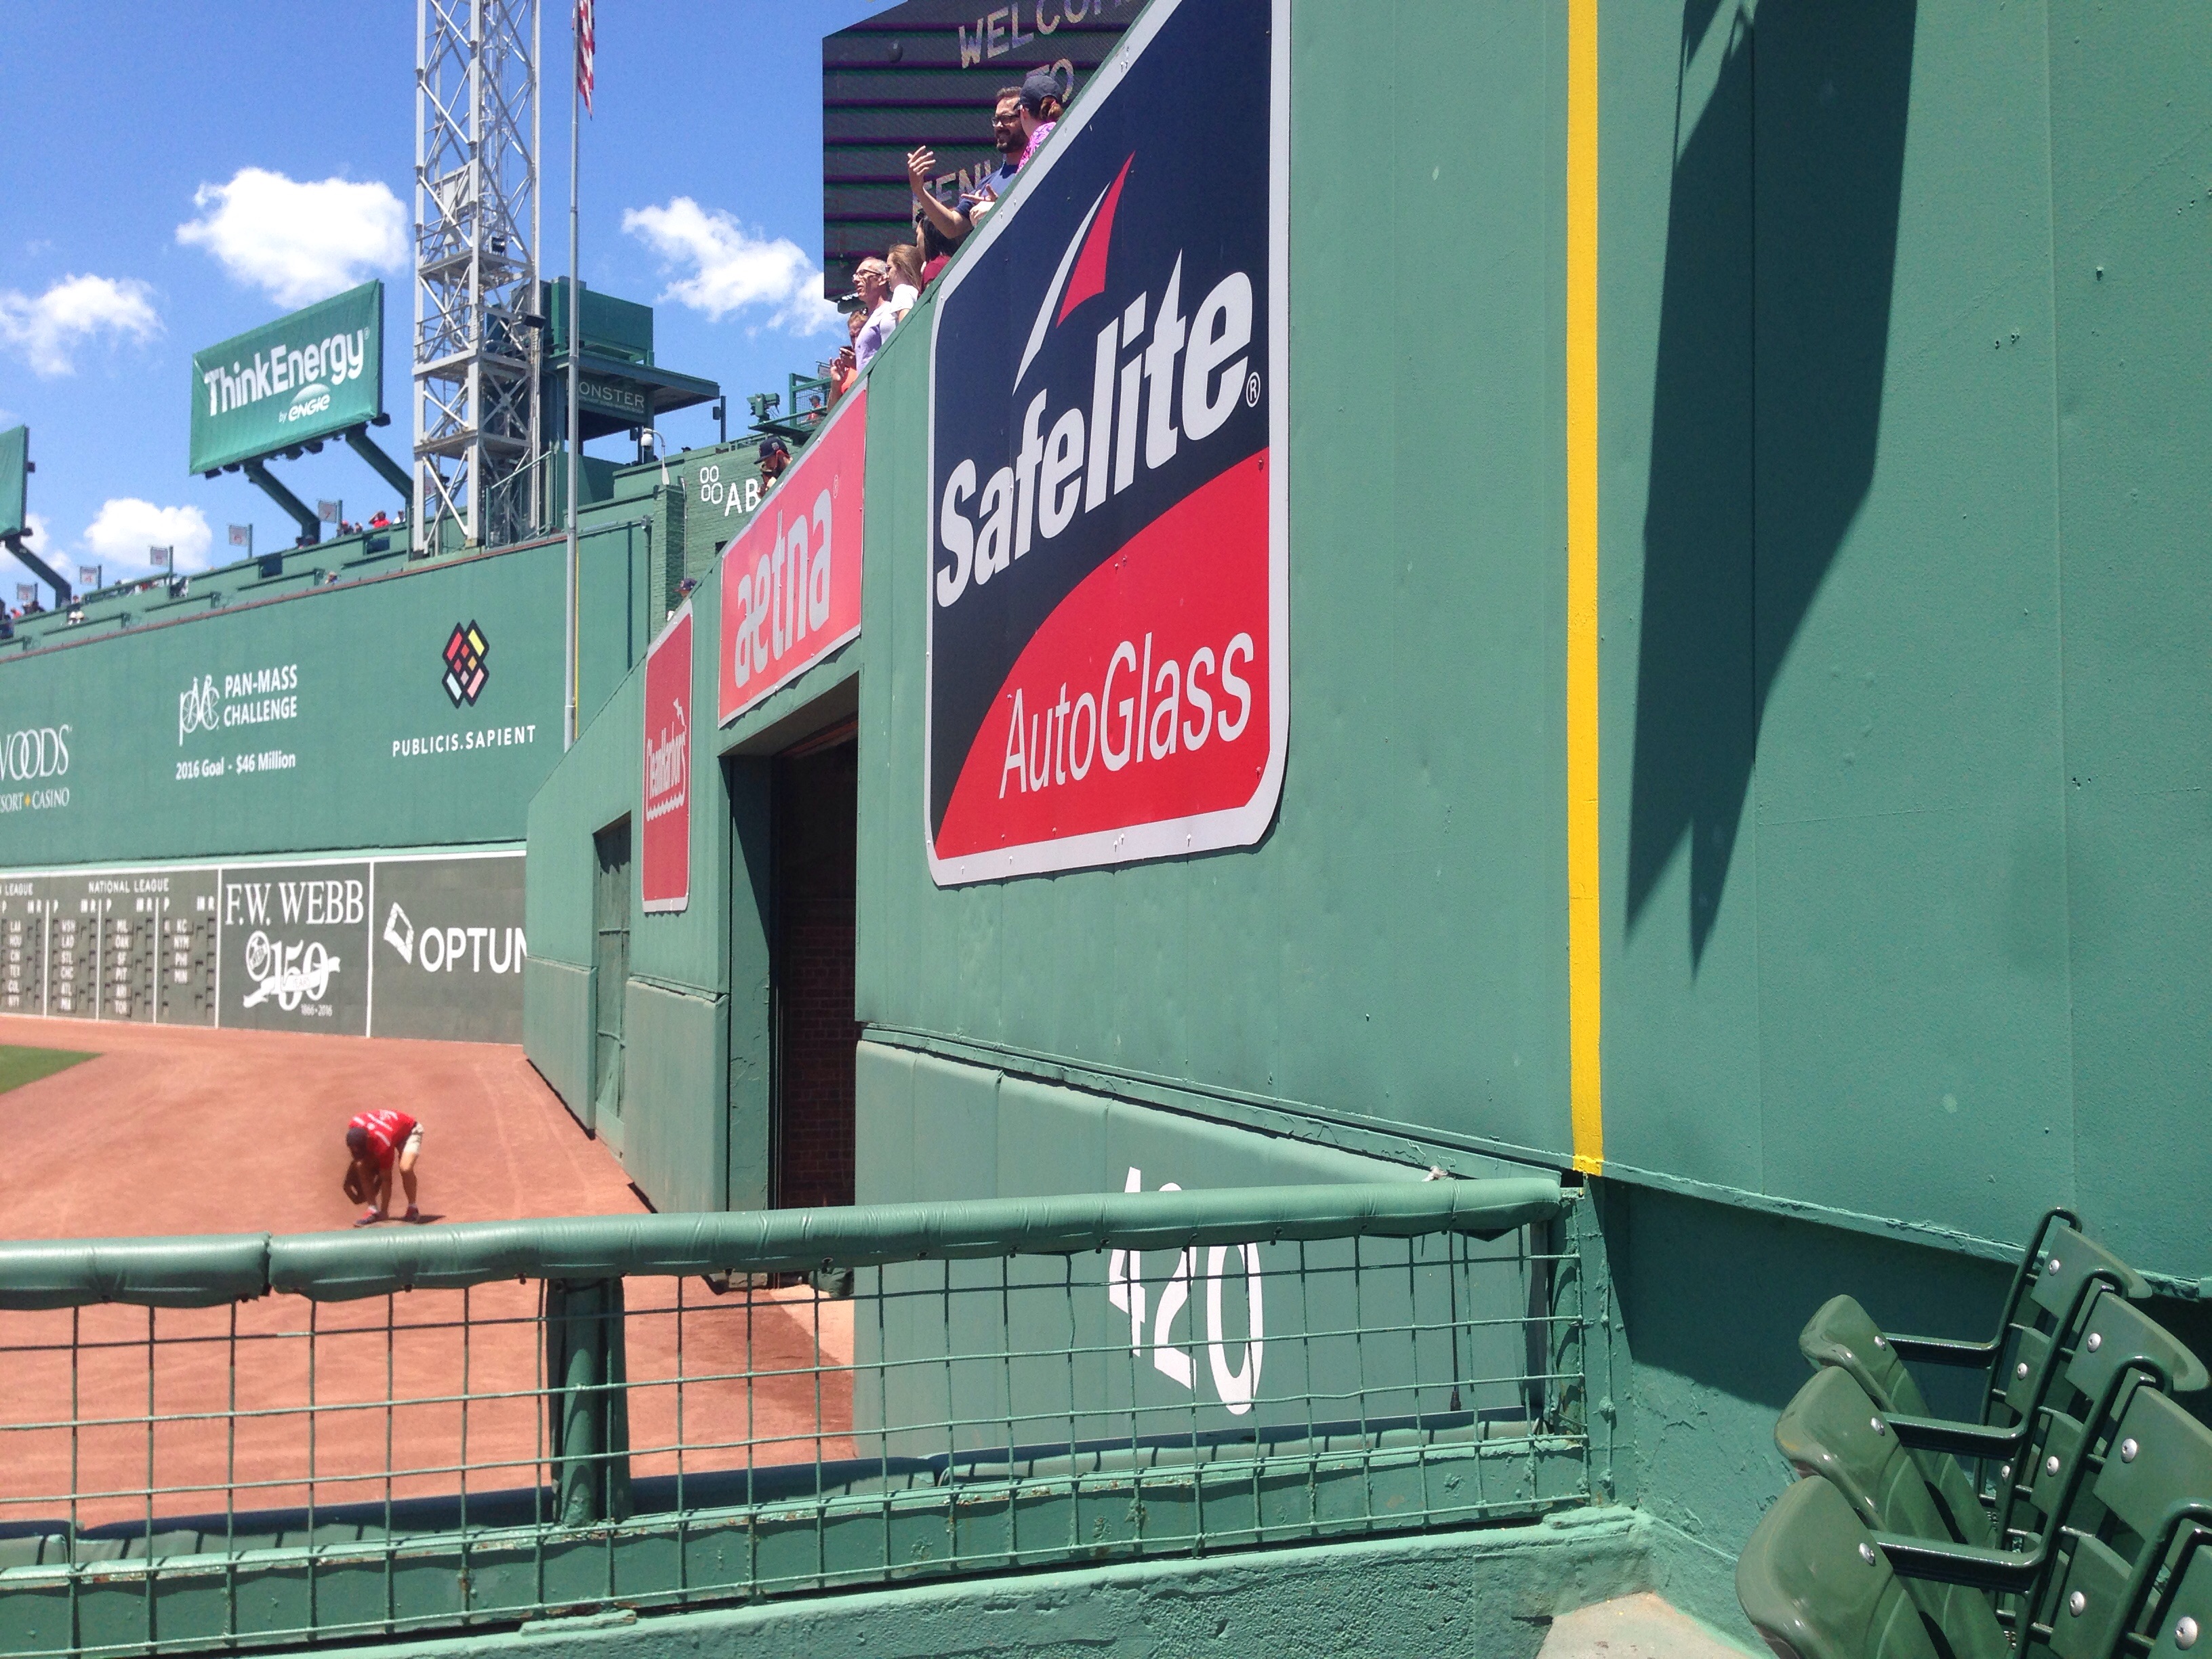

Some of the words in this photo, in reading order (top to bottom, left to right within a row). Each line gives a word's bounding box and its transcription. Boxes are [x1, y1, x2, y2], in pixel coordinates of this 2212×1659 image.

[204, 329, 365, 417] ThinkEnergy
[565, 378, 644, 408] ONSTER
[279, 411, 287, 424] by
[937, 248, 1253, 607] Safelite
[225, 663, 298, 699] PAN-MASS
[224, 695, 298, 727] CHALLENGE
[999, 632, 1254, 799] AutoGlass
[392, 724, 536, 758] PUBLICIS.SAPIENT
[176, 760, 199, 780] 2016
[201, 756, 224, 777] Goal
[237, 754, 255, 775] $46
[258, 750, 296, 772] Million
[32, 787, 70, 810] CASINO
[5, 882, 33, 897] LEAGUE
[89, 880, 130, 894] NATIONAL
[134, 878, 169, 893] LEAGUE
[225, 883, 271, 926] F.W.
[279, 880, 364, 924] WEBB
[1109, 1166, 1264, 1415] 420
